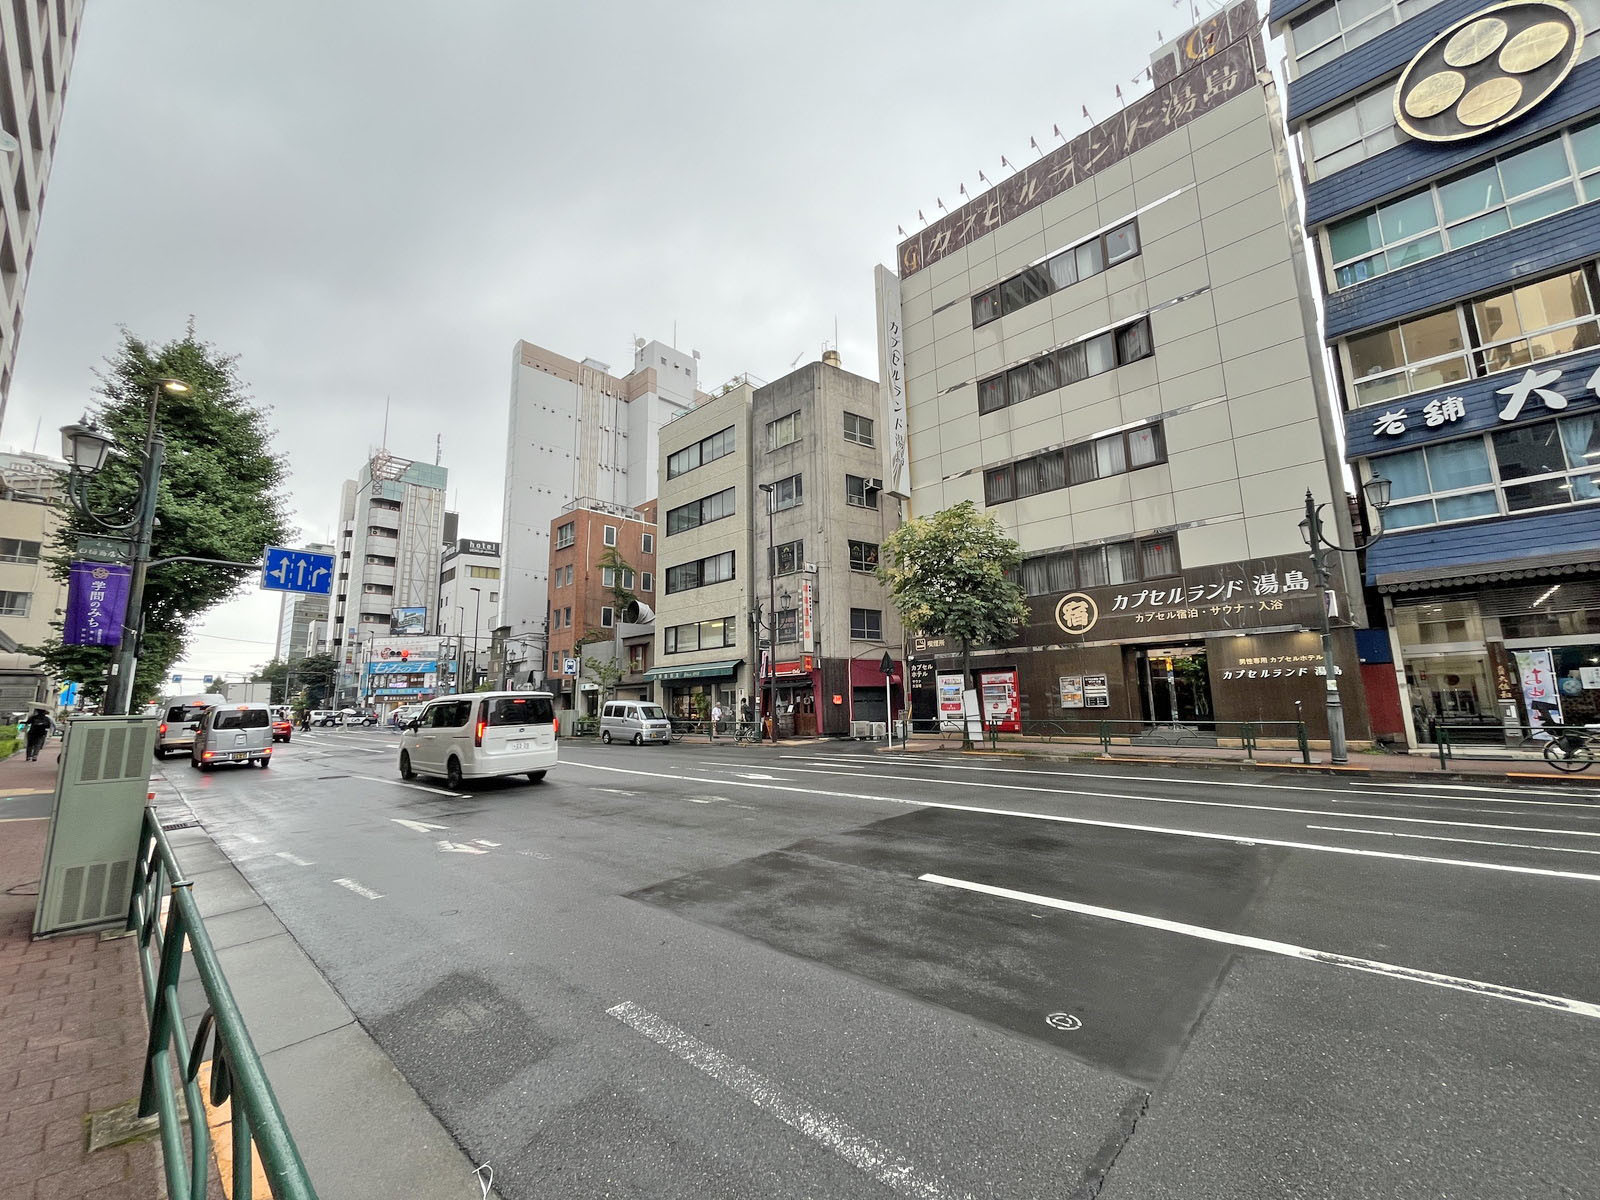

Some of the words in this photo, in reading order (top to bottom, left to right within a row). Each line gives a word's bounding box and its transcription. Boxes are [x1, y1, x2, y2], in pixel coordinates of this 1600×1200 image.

[1496, 366, 1600, 421] 大
[469, 541, 496, 551] hotel
[1253, 570, 1309, 595] 湯島
[87, 581, 107, 628] 学問のみち
[1062, 600, 1089, 628] 宿
[1223, 667, 1308, 680] カプセルランド
